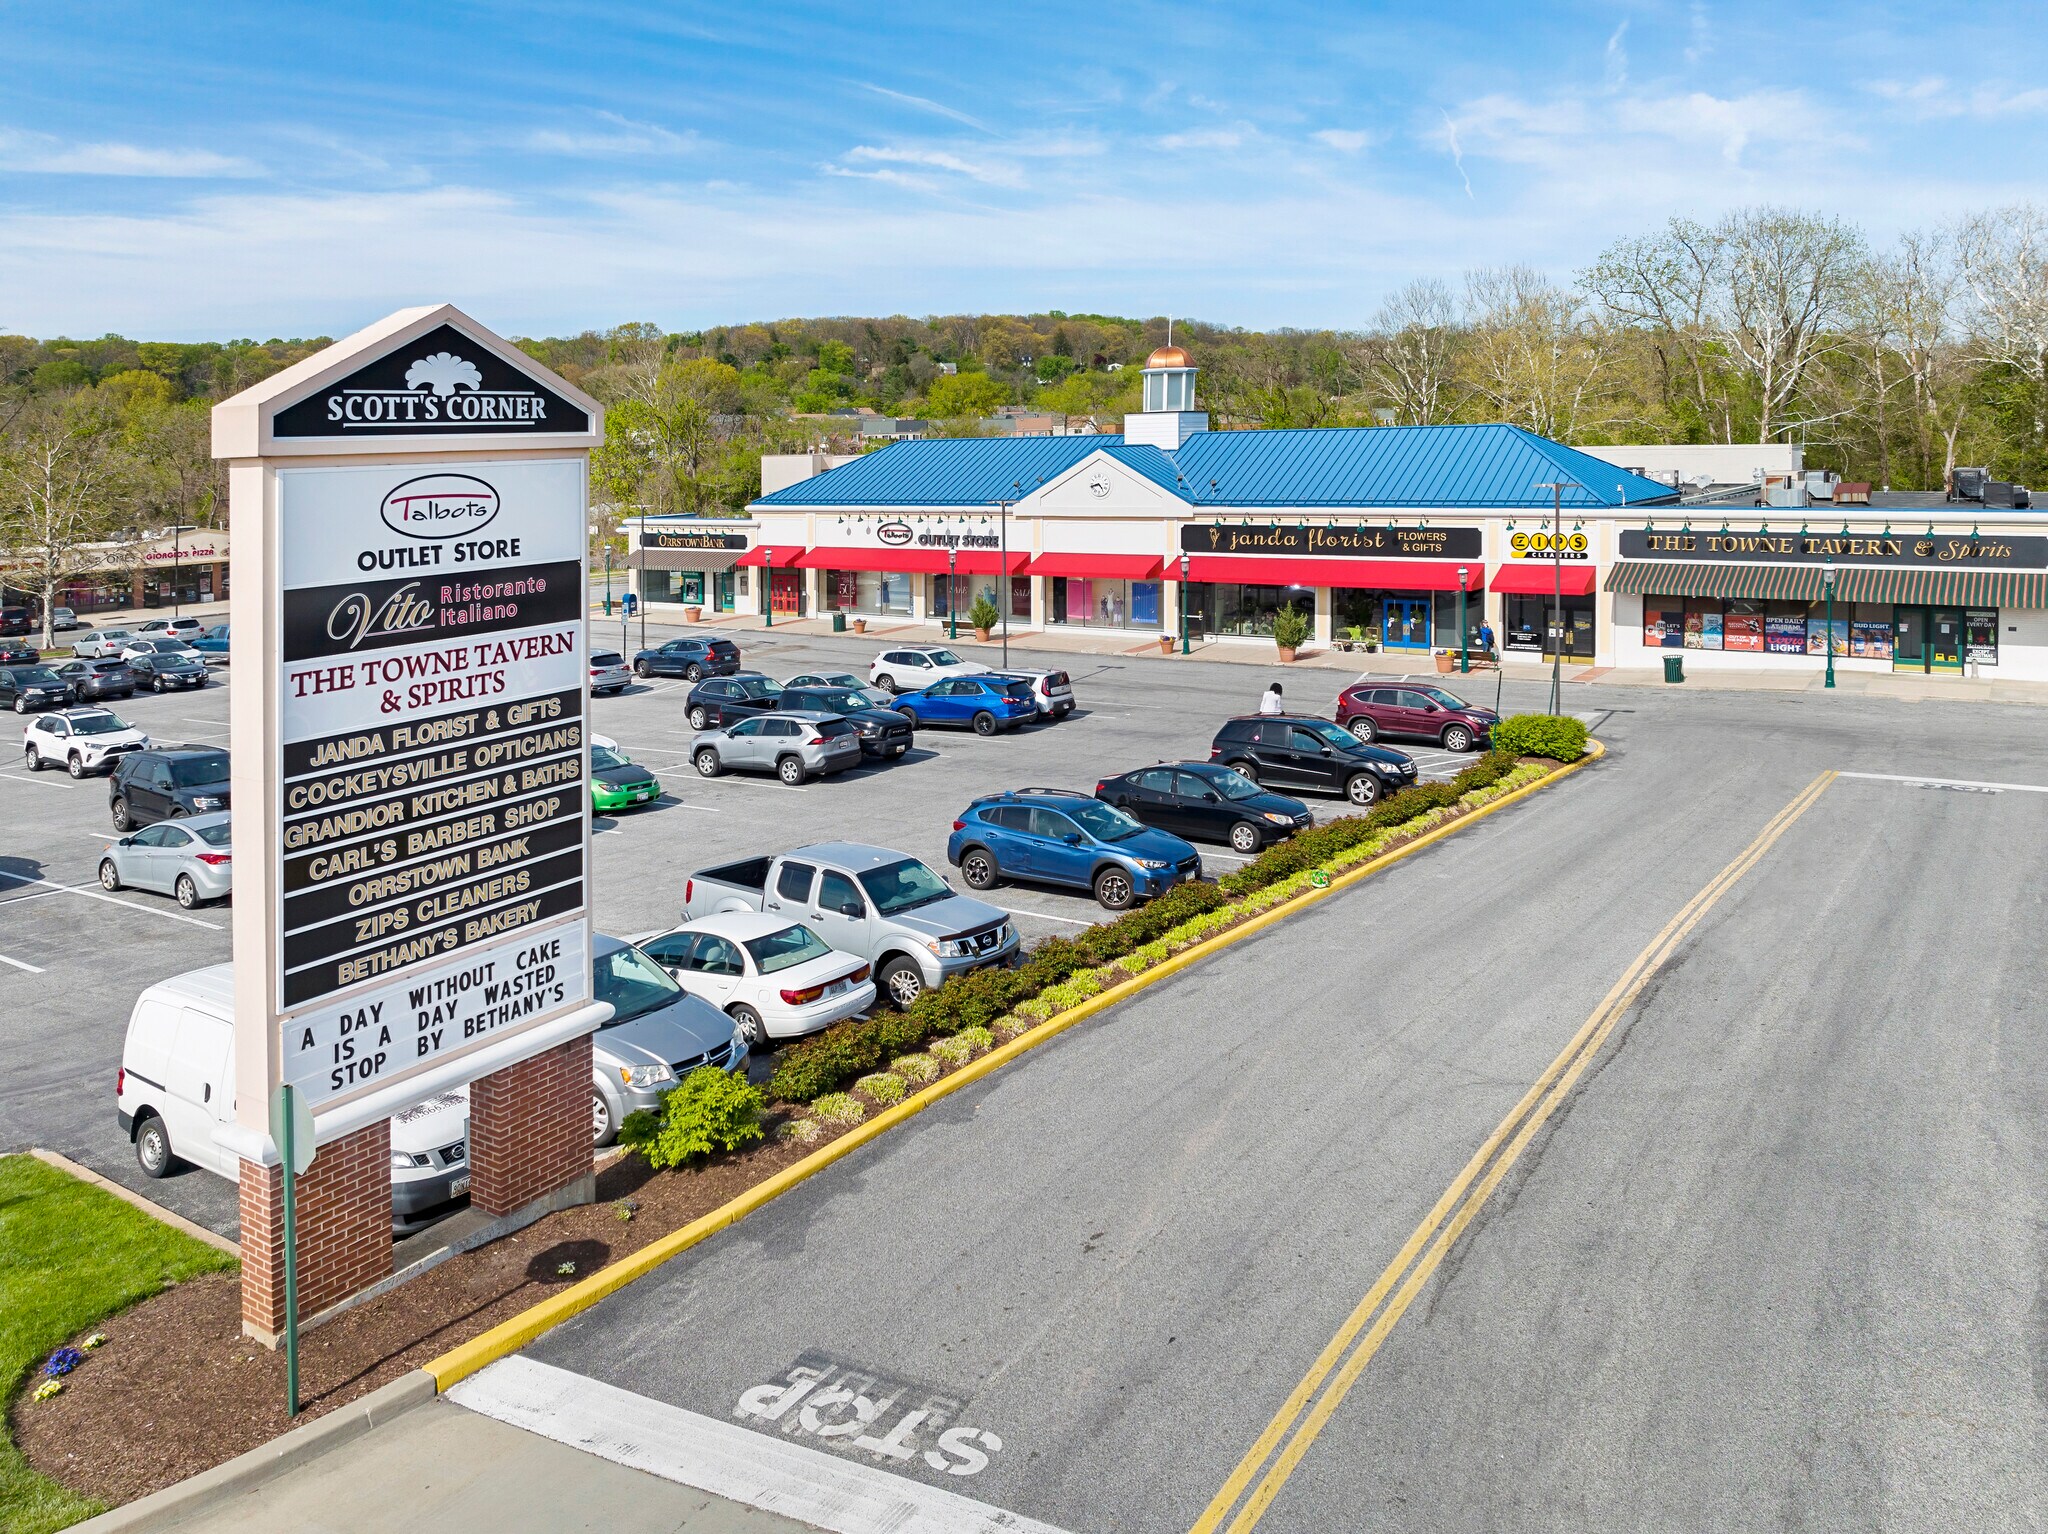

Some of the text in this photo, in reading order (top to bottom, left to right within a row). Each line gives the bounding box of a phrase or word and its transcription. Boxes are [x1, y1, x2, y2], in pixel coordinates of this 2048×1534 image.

[327, 395, 547, 421] SCOTT'S CORNER
[390, 493, 492, 522] Talbots
[918, 534, 999, 548] OUTLET STORE
[1229, 528, 1385, 552] janda florist
[1398, 532, 1447, 542] FLOWERS
[192, 549, 214, 557] PIZZA
[357, 538, 521, 572] OUTLET STORE
[1402, 543, 1442, 552] & GIFTS
[1648, 536, 2012, 561] THE TOWNE TAVERN & Spirits
[327, 577, 547, 649] Vito Ristorante
[440, 603, 518, 626] Italiano
[290, 631, 575, 698] THE TOWNE TAVERN
[1770, 644, 1801, 653] LIGHT
[380, 670, 506, 714] & SPIRITS
[309, 697, 562, 768] JANDA FLORIST & GIFTS
[289, 726, 581, 809] COCKEYSVILLE OPTICIANS
[284, 758, 579, 849] GRANDIOR KITCHEN & BATHS
[309, 796, 561, 881] CARL'S BARBER SHOP
[348, 836, 530, 906] ORRSTOWN BANK
[355, 870, 530, 943] ZIPS CLEANERS
[338, 900, 541, 986] BETHANY'S BAKERY
[300, 939, 561, 1051] A DAY WITHOUT CAKE
[334, 964, 556, 1064] IS A DAY WASTED
[331, 982, 565, 1091] STOP BY BETHANY'S
[738, 1376, 1003, 1476] STOP
